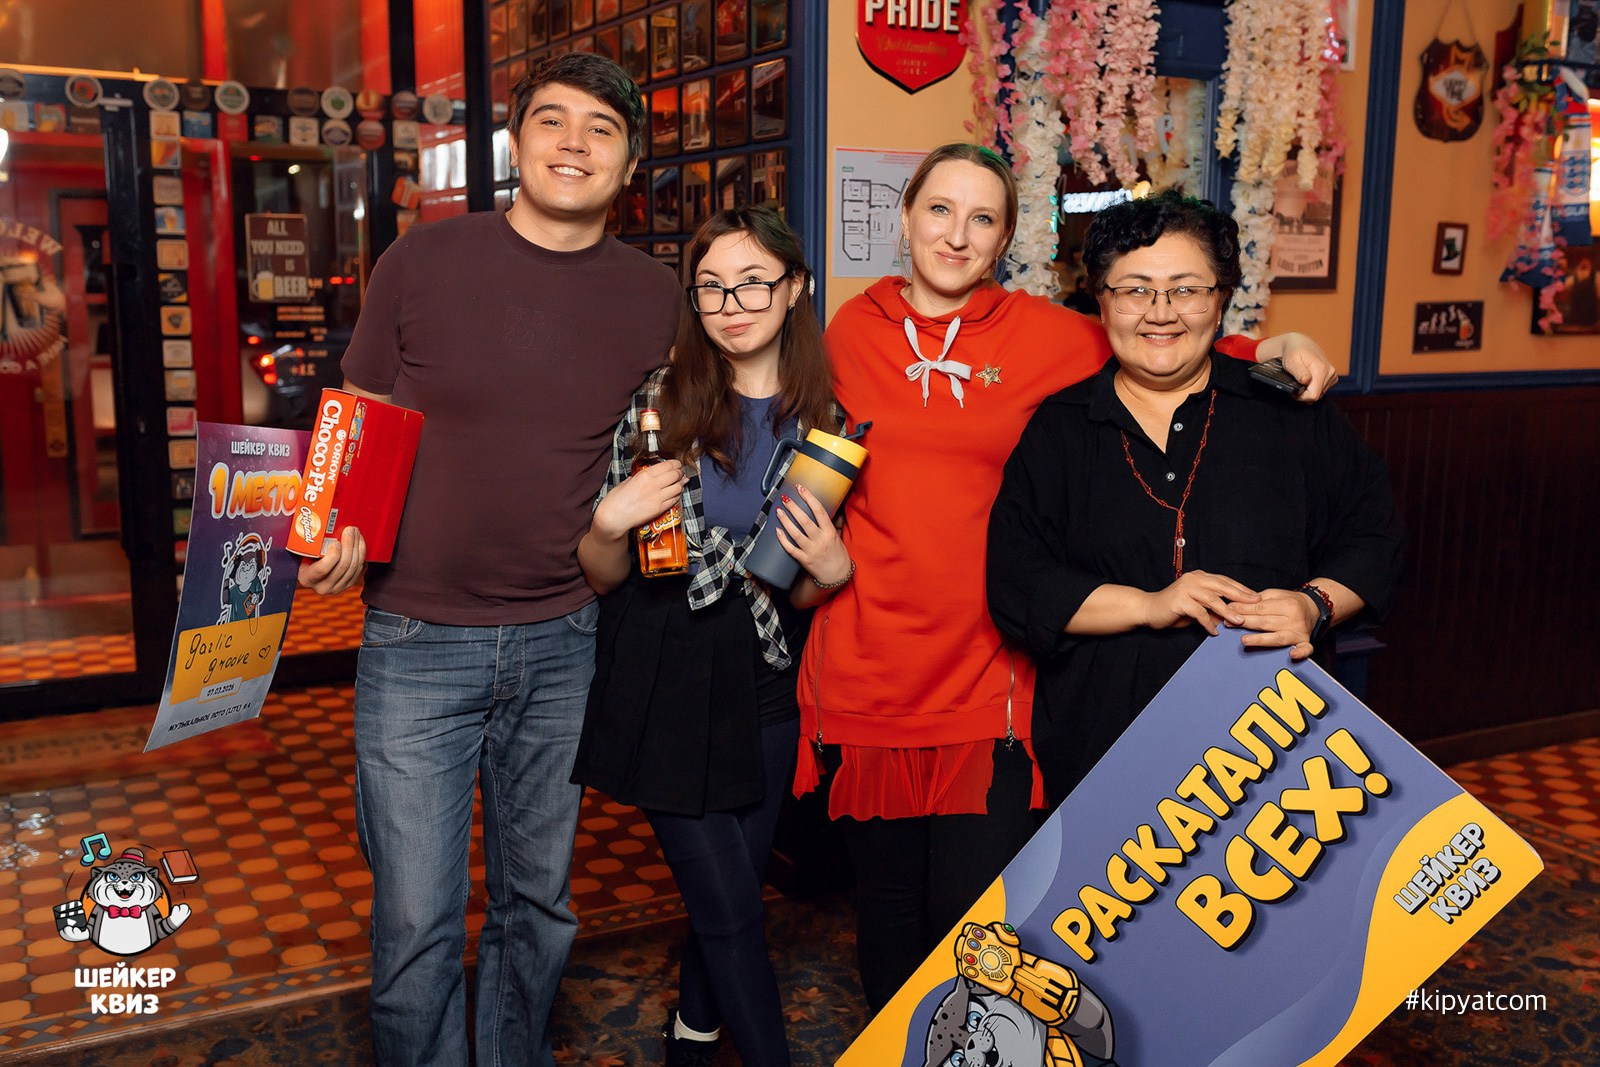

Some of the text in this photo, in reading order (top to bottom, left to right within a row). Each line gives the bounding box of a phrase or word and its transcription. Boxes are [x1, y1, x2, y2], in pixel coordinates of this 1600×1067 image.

[864, 0, 961, 32] PRIDE
[266, 220, 288, 236] ALL
[251, 240, 305, 255] YOU NEED
[284, 259, 295, 272] IS
[274, 276, 308, 298] BEER
[231, 438, 291, 457] ШЕЙКЕР КВИЗ
[326, 442, 343, 482] ORION
[209, 462, 302, 519] 1 МЕСТО
[300, 506, 315, 543] Original
[185, 633, 233, 670] garlic
[203, 652, 250, 684] groove
[1051, 668, 1330, 964] РАСКАТАЛИ
[1175, 728, 1393, 952] ВСЕХ!
[1393, 822, 1485, 915] ШЕЙКЕР
[1429, 857, 1502, 925] КВИЗ
